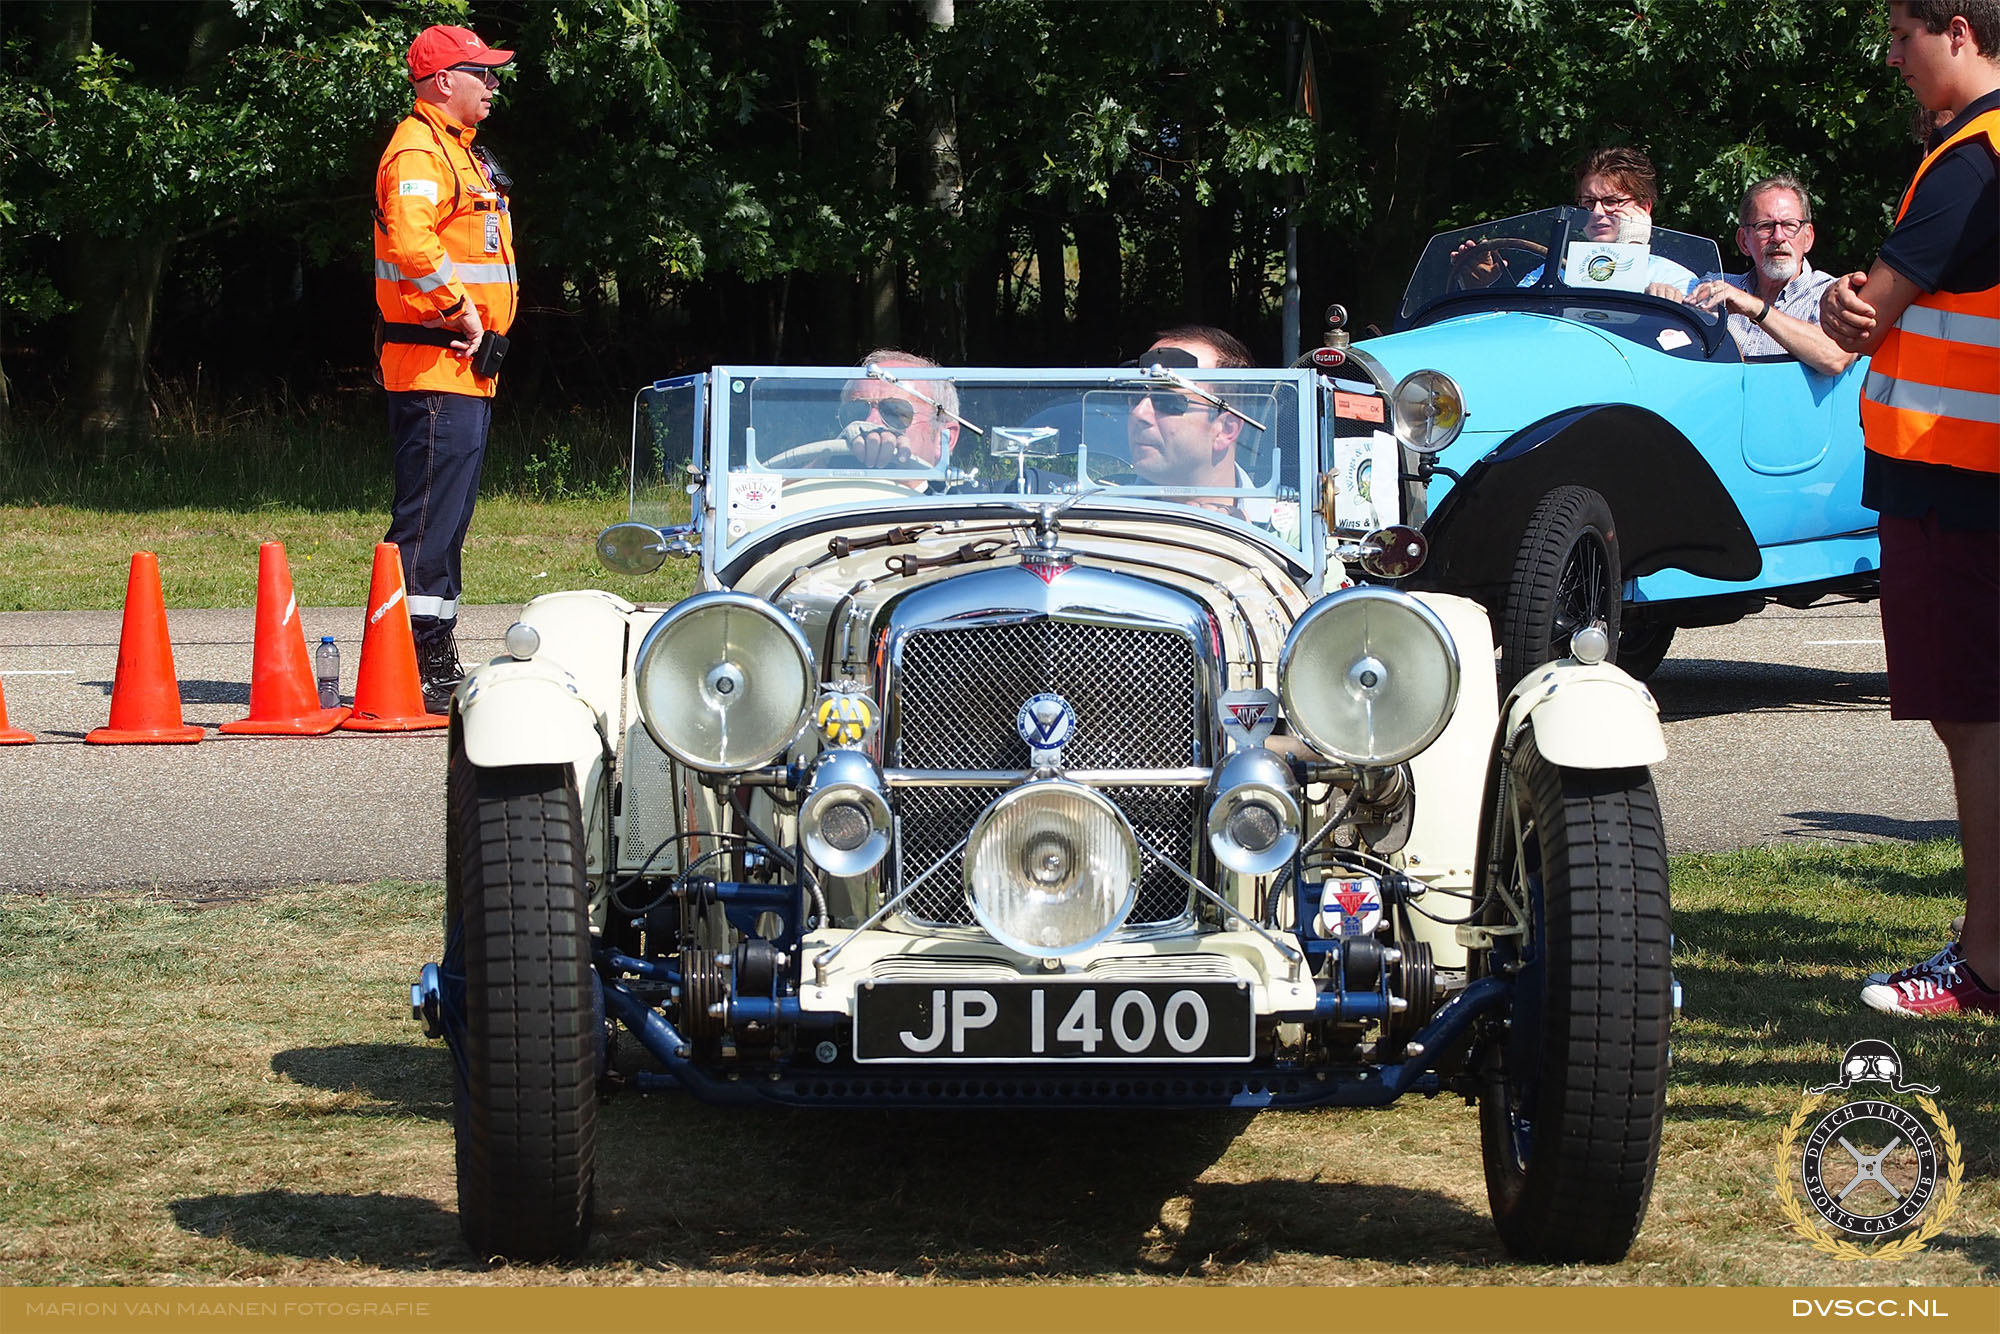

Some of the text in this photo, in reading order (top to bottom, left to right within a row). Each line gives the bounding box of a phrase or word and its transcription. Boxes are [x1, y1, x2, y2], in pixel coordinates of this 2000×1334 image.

[1316, 354, 1341, 362] BUGATTI
[1370, 405, 1380, 413] OK
[1345, 458, 1356, 493] Wings
[735, 482, 776, 496] BRITISH
[1364, 518, 1370, 527] &
[1032, 564, 1064, 580] ALVIS
[1236, 708, 1260, 724] ALVIS
[1340, 895, 1362, 913] ALVIS
[898, 989, 1210, 1052] JP 1400
